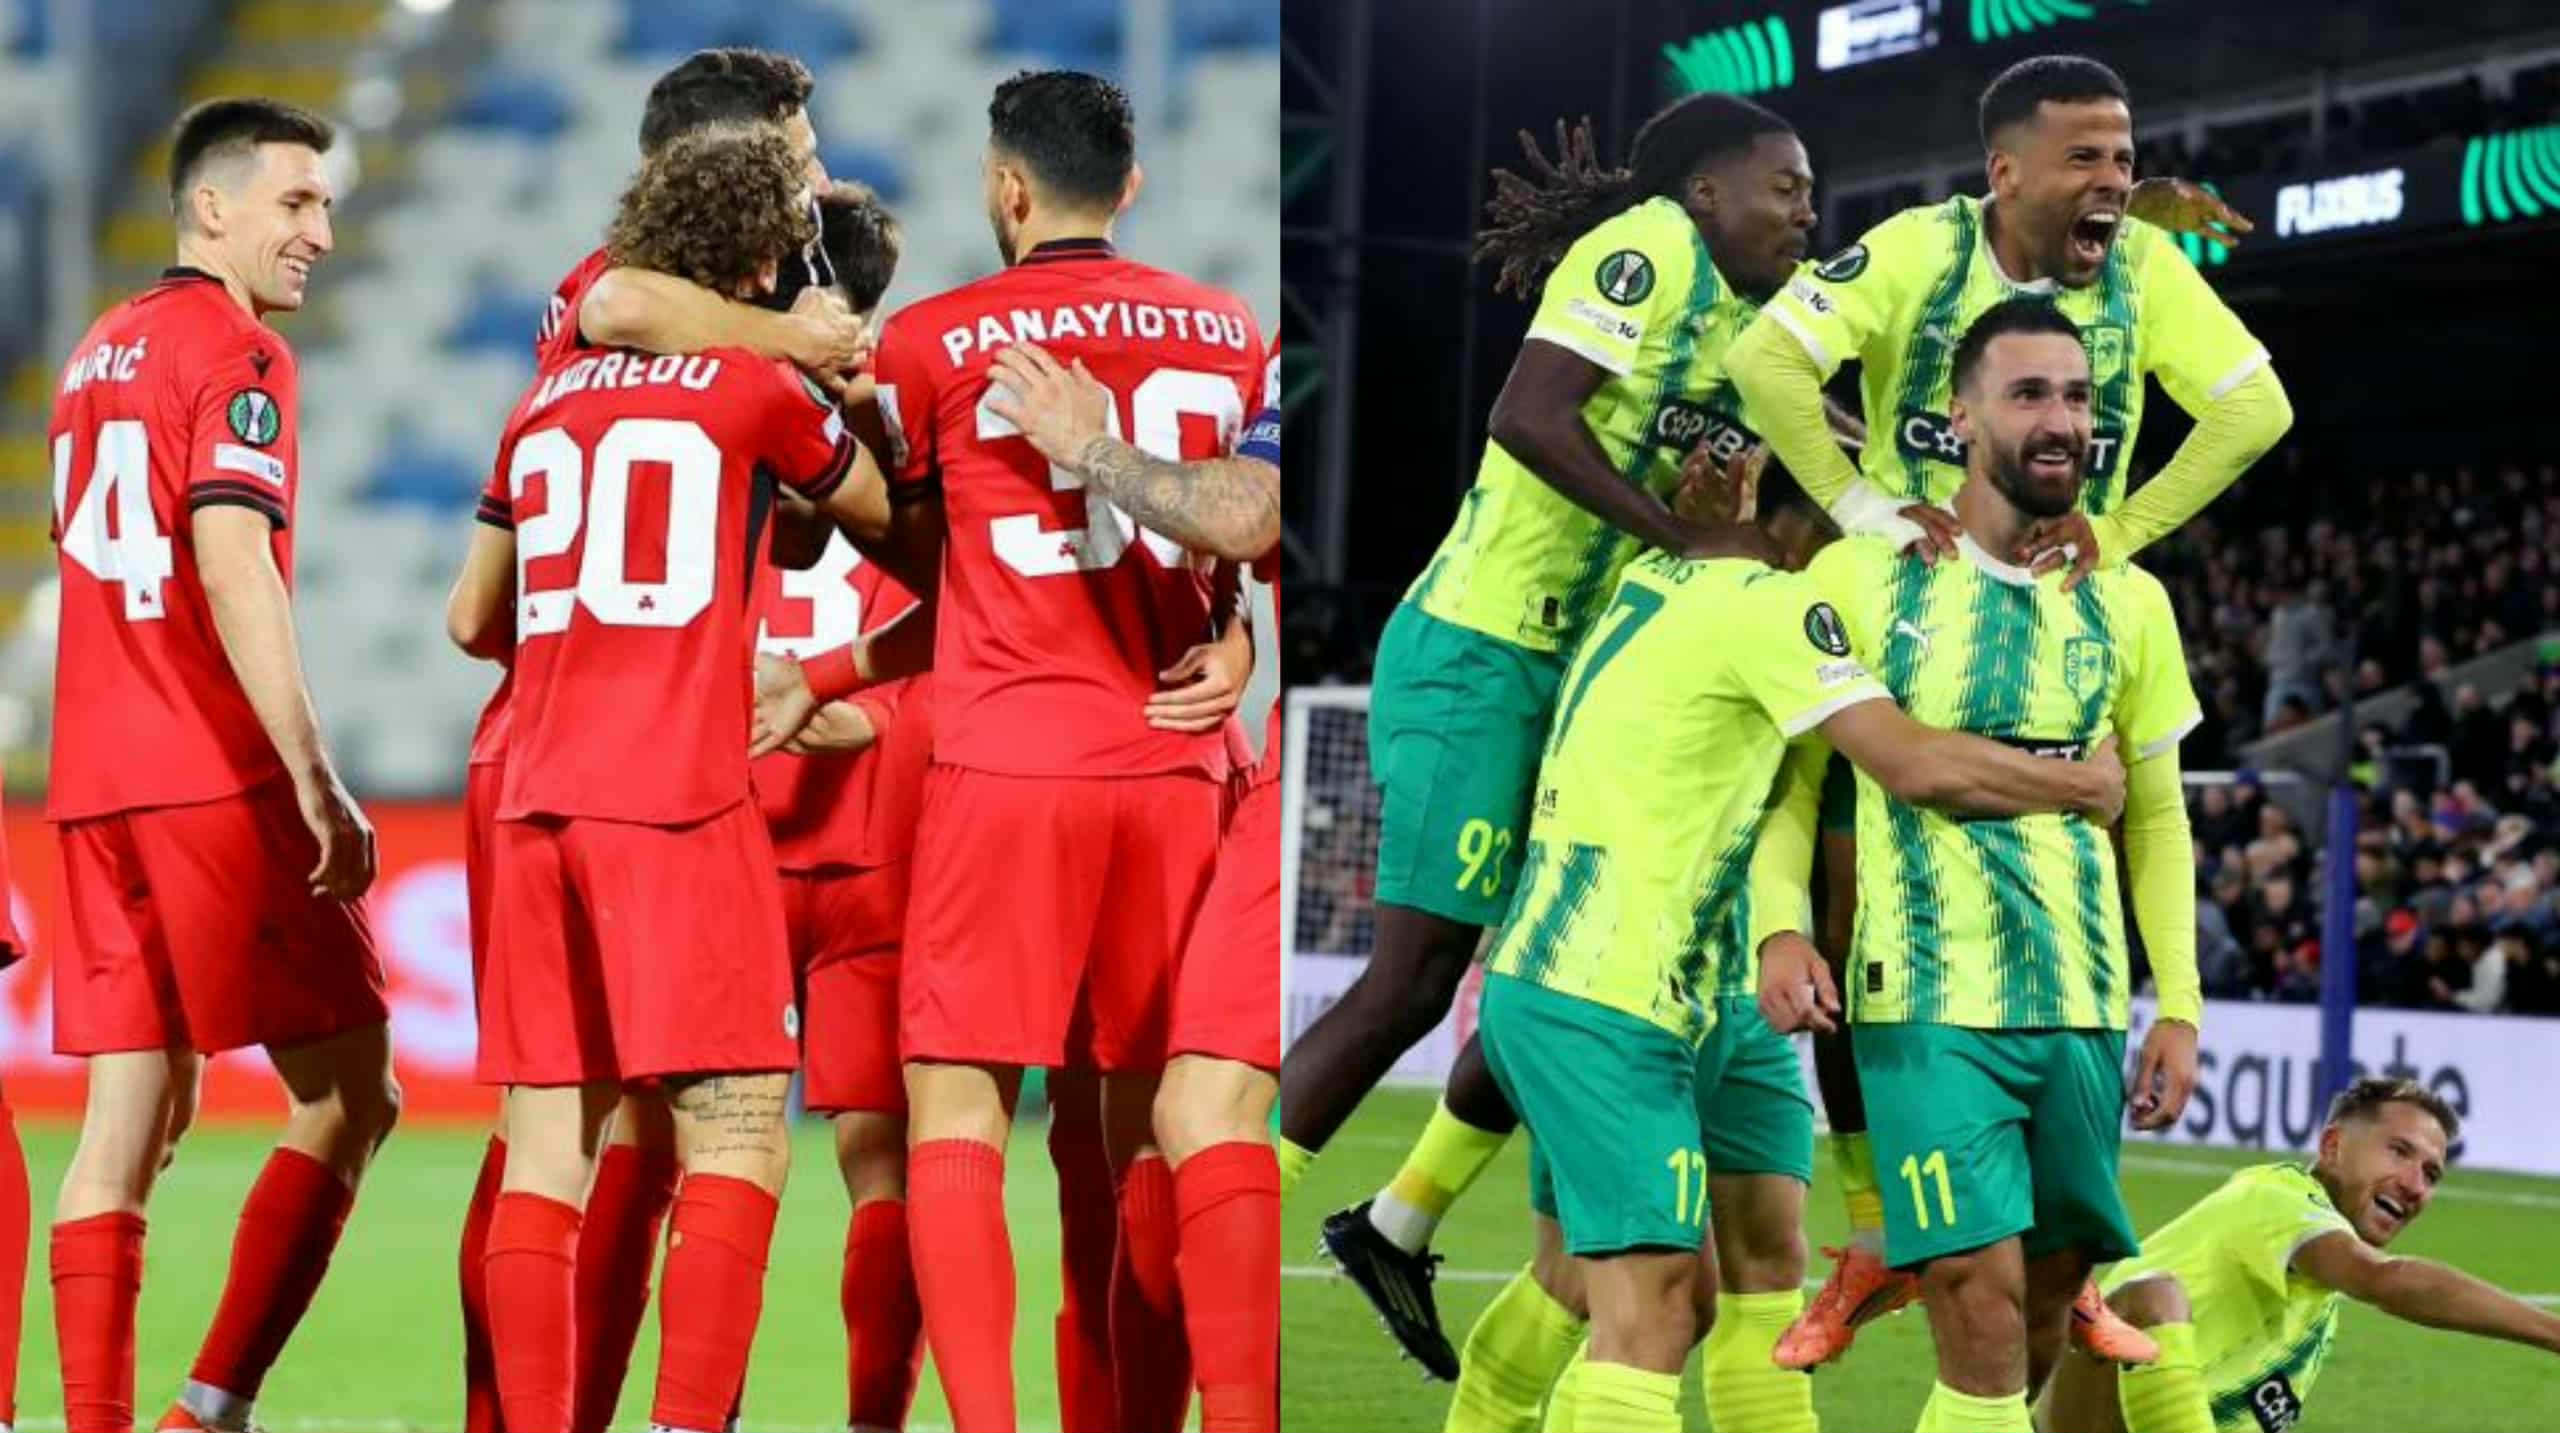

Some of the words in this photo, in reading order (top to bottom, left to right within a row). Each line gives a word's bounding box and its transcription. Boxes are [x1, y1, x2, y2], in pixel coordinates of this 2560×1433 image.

[941, 302, 1248, 367] PANAYIOTOU
[509, 416, 722, 647] 20
[1456, 818, 1512, 897] 93
[1667, 1148, 1706, 1227] 17
[1901, 1150, 1957, 1229] 11
